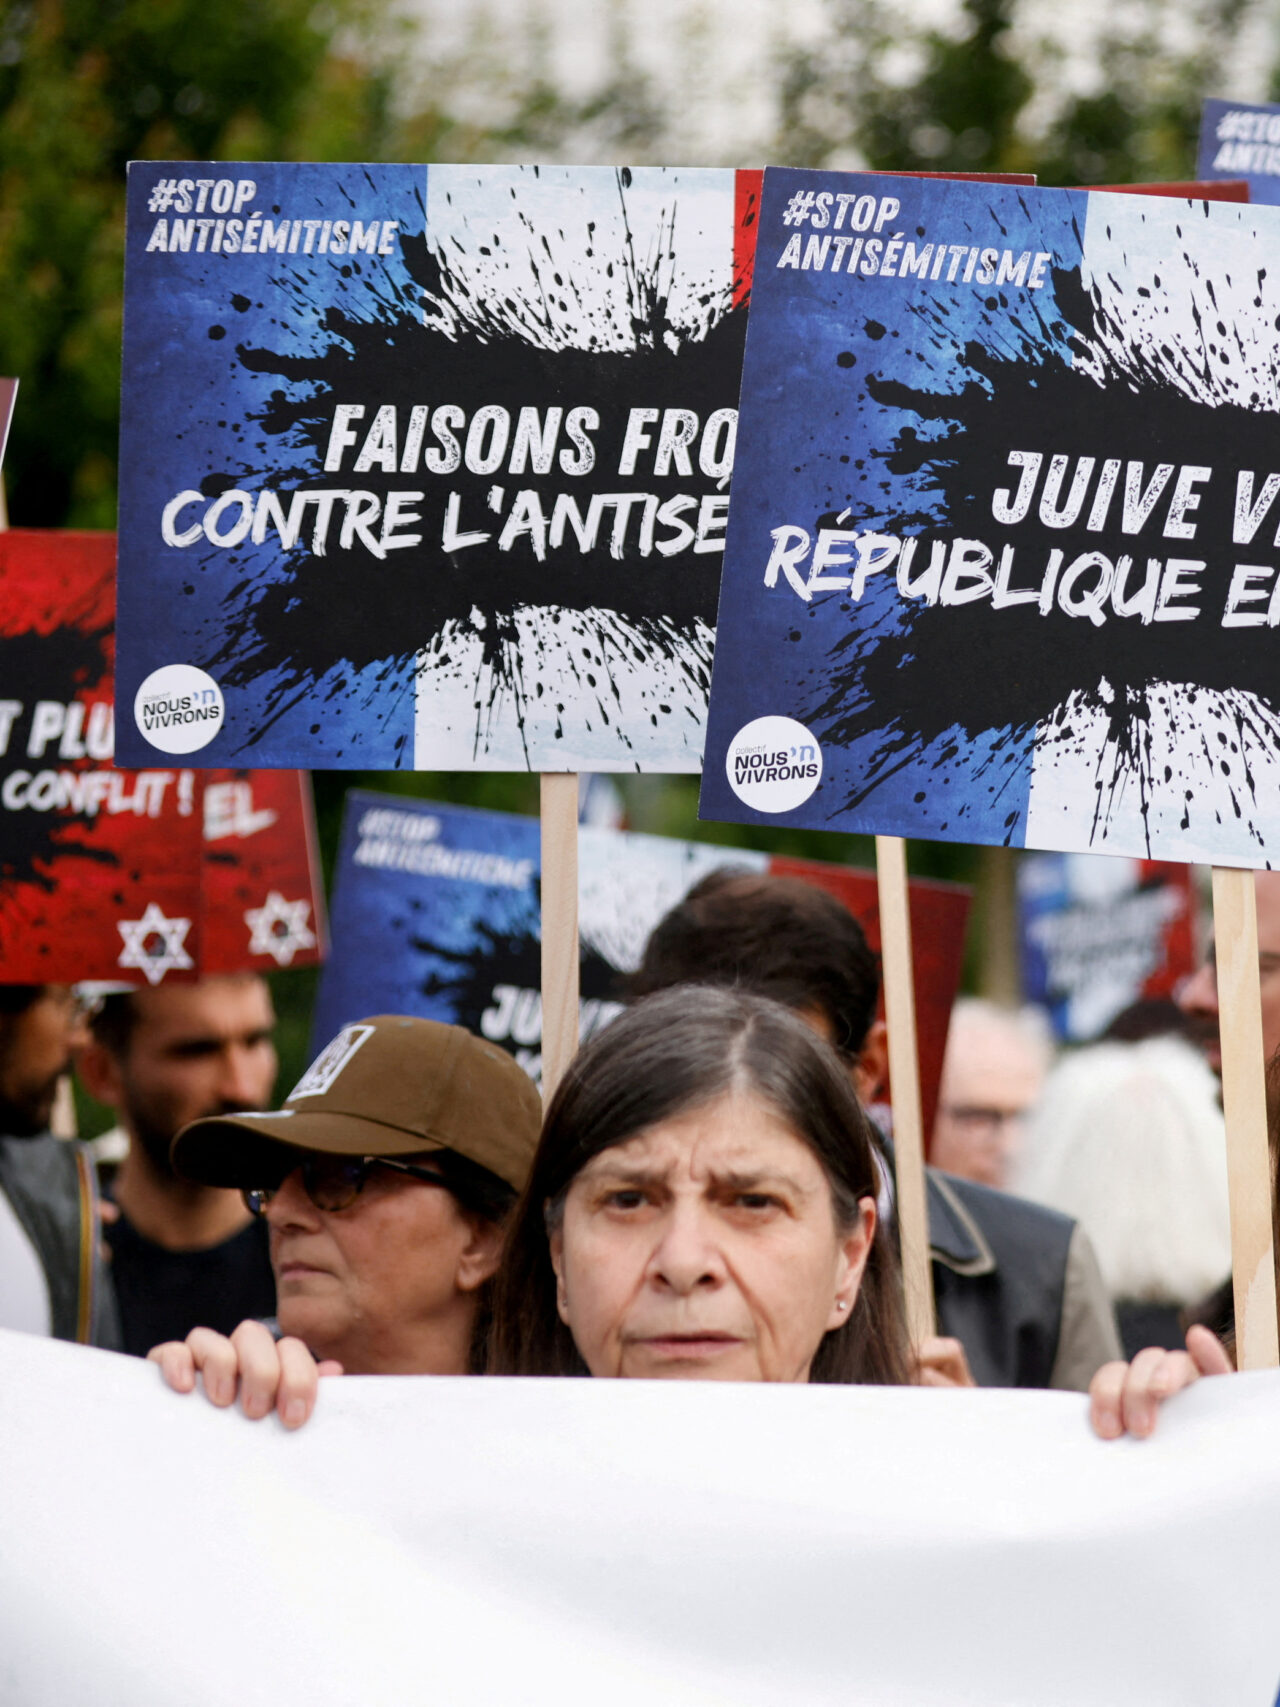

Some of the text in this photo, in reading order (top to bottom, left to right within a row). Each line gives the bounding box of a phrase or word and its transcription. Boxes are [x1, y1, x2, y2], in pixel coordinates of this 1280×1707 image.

[147, 179, 256, 213] #STOP
[782, 190, 900, 233] #STOP
[146, 212, 398, 255] ANTISÉMITISME
[776, 231, 1052, 288] ANTISÉMITISME
[324, 404, 600, 476] FAISONS
[991, 450, 1212, 540] JUIVE
[161, 488, 424, 559] CONTRE
[764, 507, 1206, 627] RÉPUBLIQUE
[143, 697, 191, 717] NOUS
[144, 706, 220, 730] VIVRONS
[735, 751, 788, 770] NOUS
[735, 764, 818, 785] VIVRONS
[2, 769, 175, 818] CONFLIT
